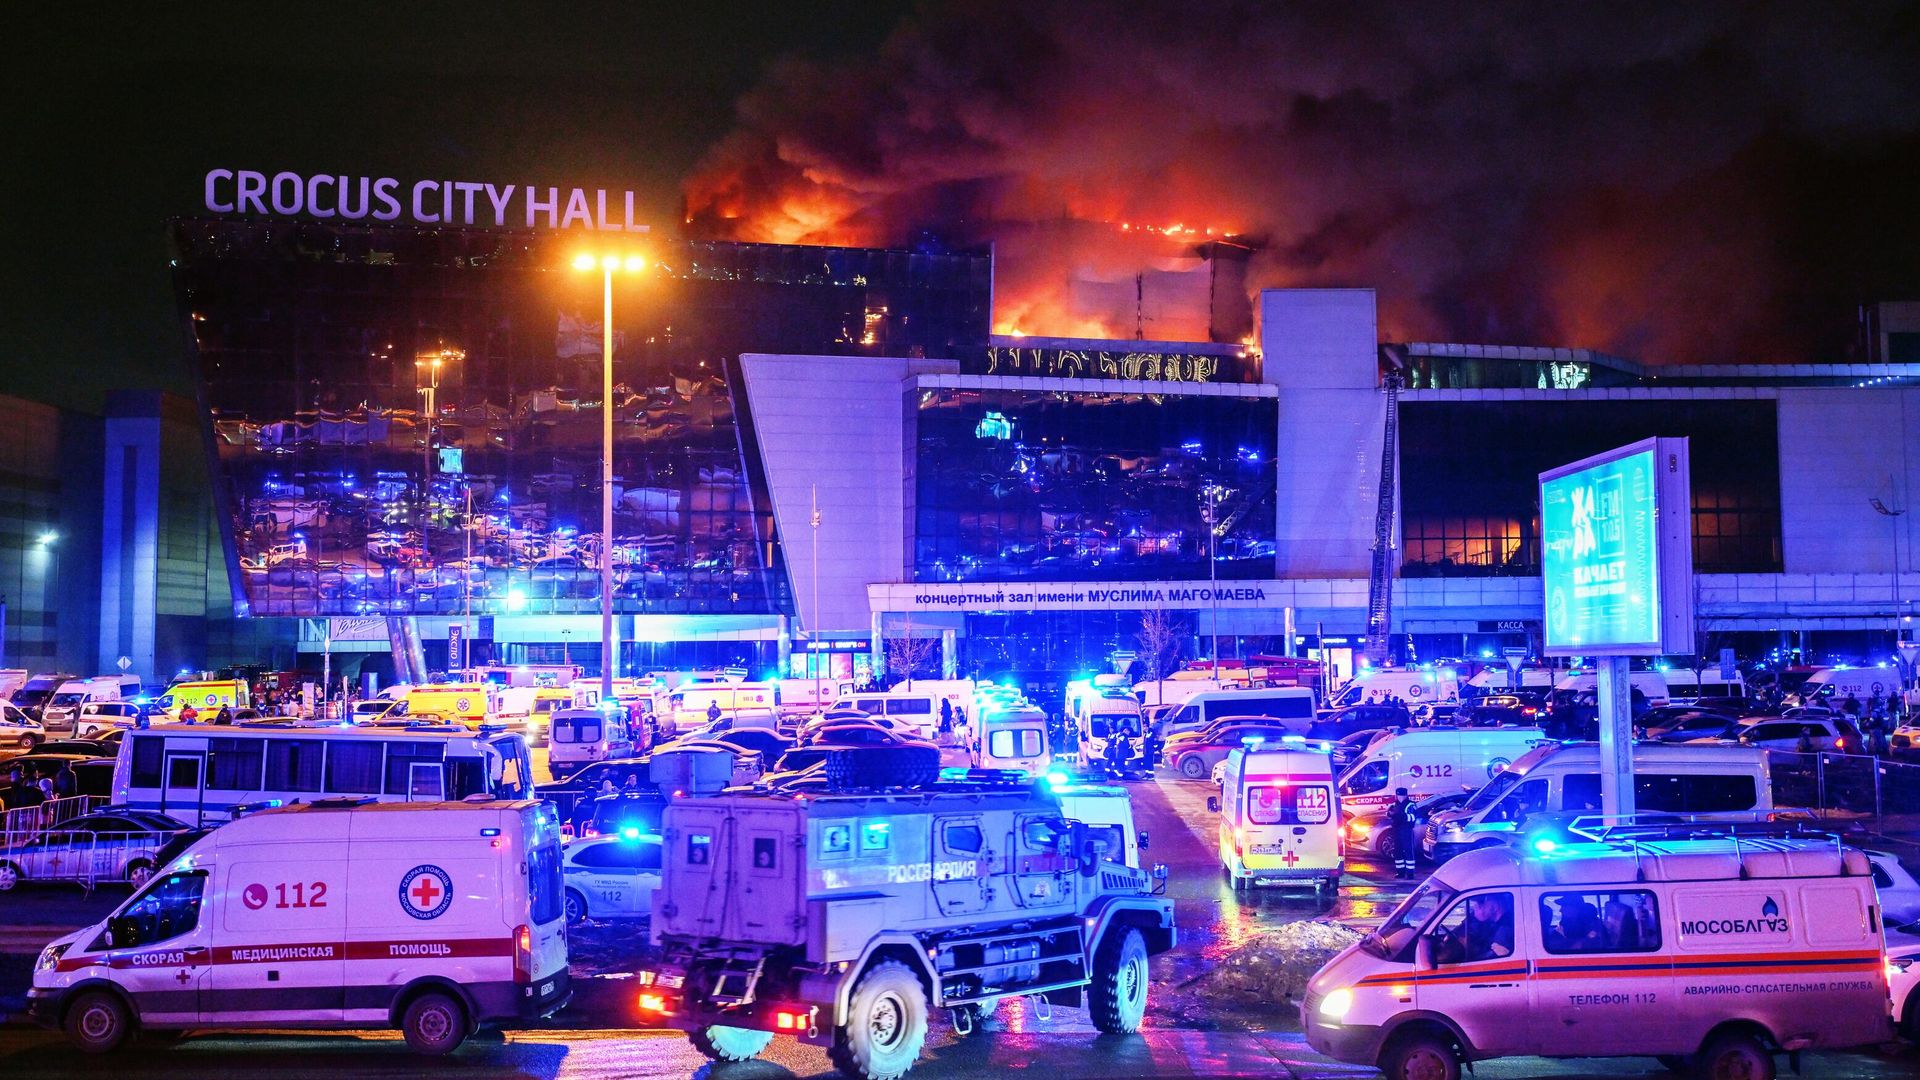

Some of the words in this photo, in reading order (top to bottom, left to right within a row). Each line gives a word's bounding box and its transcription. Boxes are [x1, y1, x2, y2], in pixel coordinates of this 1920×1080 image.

[205, 168, 401, 221] CROCUS
[412, 179, 516, 226] CITY
[526, 186, 650, 232] HALL
[1574, 561, 1626, 585] КАЧАЕТ
[916, 591, 1004, 606] концертный
[1009, 593, 1033, 603] зал
[1038, 592, 1083, 602] имени
[1088, 590, 1165, 602] МУСЛИМА
[1168, 589, 1266, 601] МАГОМАЕВА
[1497, 621, 1524, 629] КАССА
[451, 629, 459, 660] ЭКСПО
[1425, 764, 1453, 778] 112
[1297, 794, 1326, 808] 112
[402, 866, 424, 888] СКОРАЯ
[425, 866, 450, 887] ПОМОЩЬ
[888, 860, 977, 883] РОСГВАРДИЯ
[275, 881, 327, 909] 112
[401, 892, 432, 918] МОСКОВСКАЯ
[432, 892, 451, 917] ОБЛАСТЬ
[601, 890, 622, 902] 112
[132, 952, 185, 965] СКОРАЯ
[231, 946, 334, 962] МЕДИЦИНСКАЯ
[389, 943, 452, 956] ПОМОЩЬ
[1569, 993, 1630, 1006] ТЕЛЕФОН
[1634, 992, 1657, 1004] 112
[1684, 981, 1827, 996] АВАРИЙНО-СПАСАТЕЛЬНАЯ
[1829, 980, 1874, 992] СЛУЖБА
